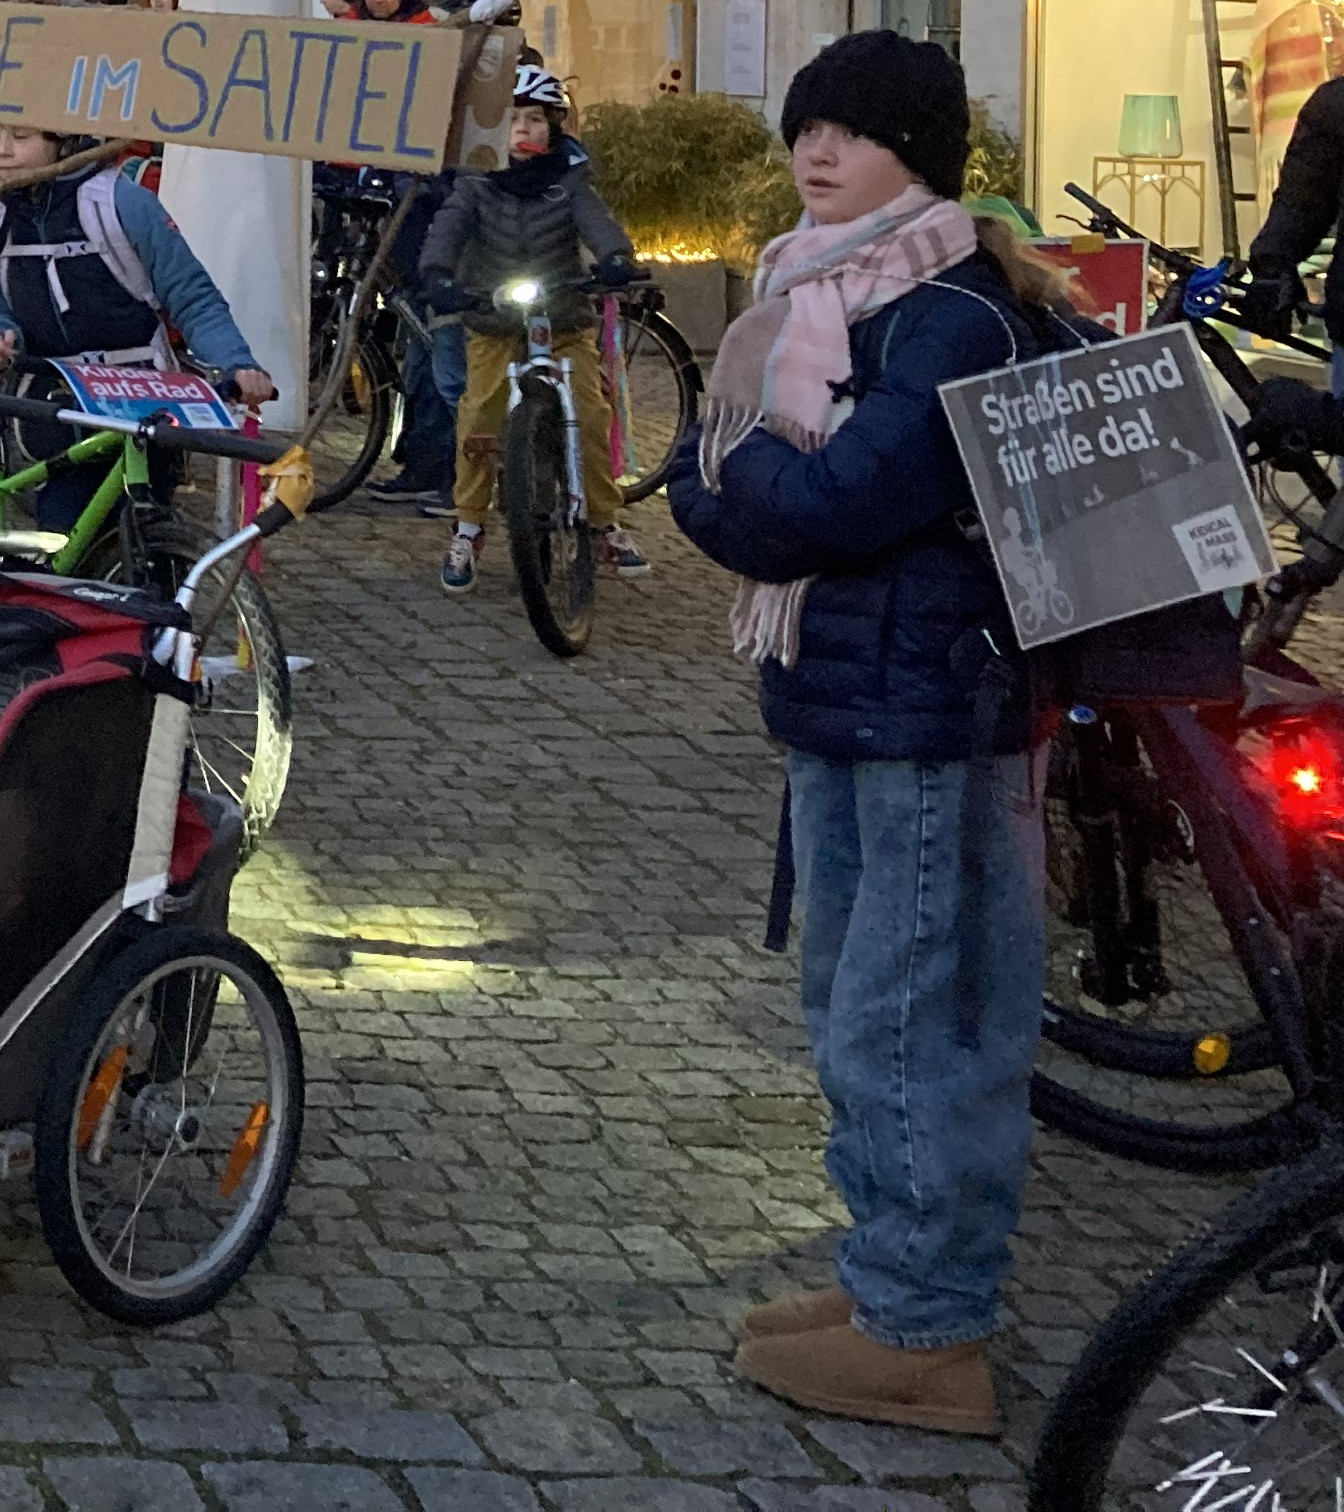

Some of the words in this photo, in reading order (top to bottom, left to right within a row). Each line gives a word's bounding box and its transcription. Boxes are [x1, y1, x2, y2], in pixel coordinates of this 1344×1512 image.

[150, 20, 437, 159] SATTEL
[89, 379, 149, 397] aufs
[147, 380, 205, 399] Rad
[981, 378, 1097, 436] Straßen
[1096, 346, 1185, 404] sind
[997, 438, 1039, 487] für
[1042, 428, 1096, 476] alle
[1097, 407, 1160, 458] da!
